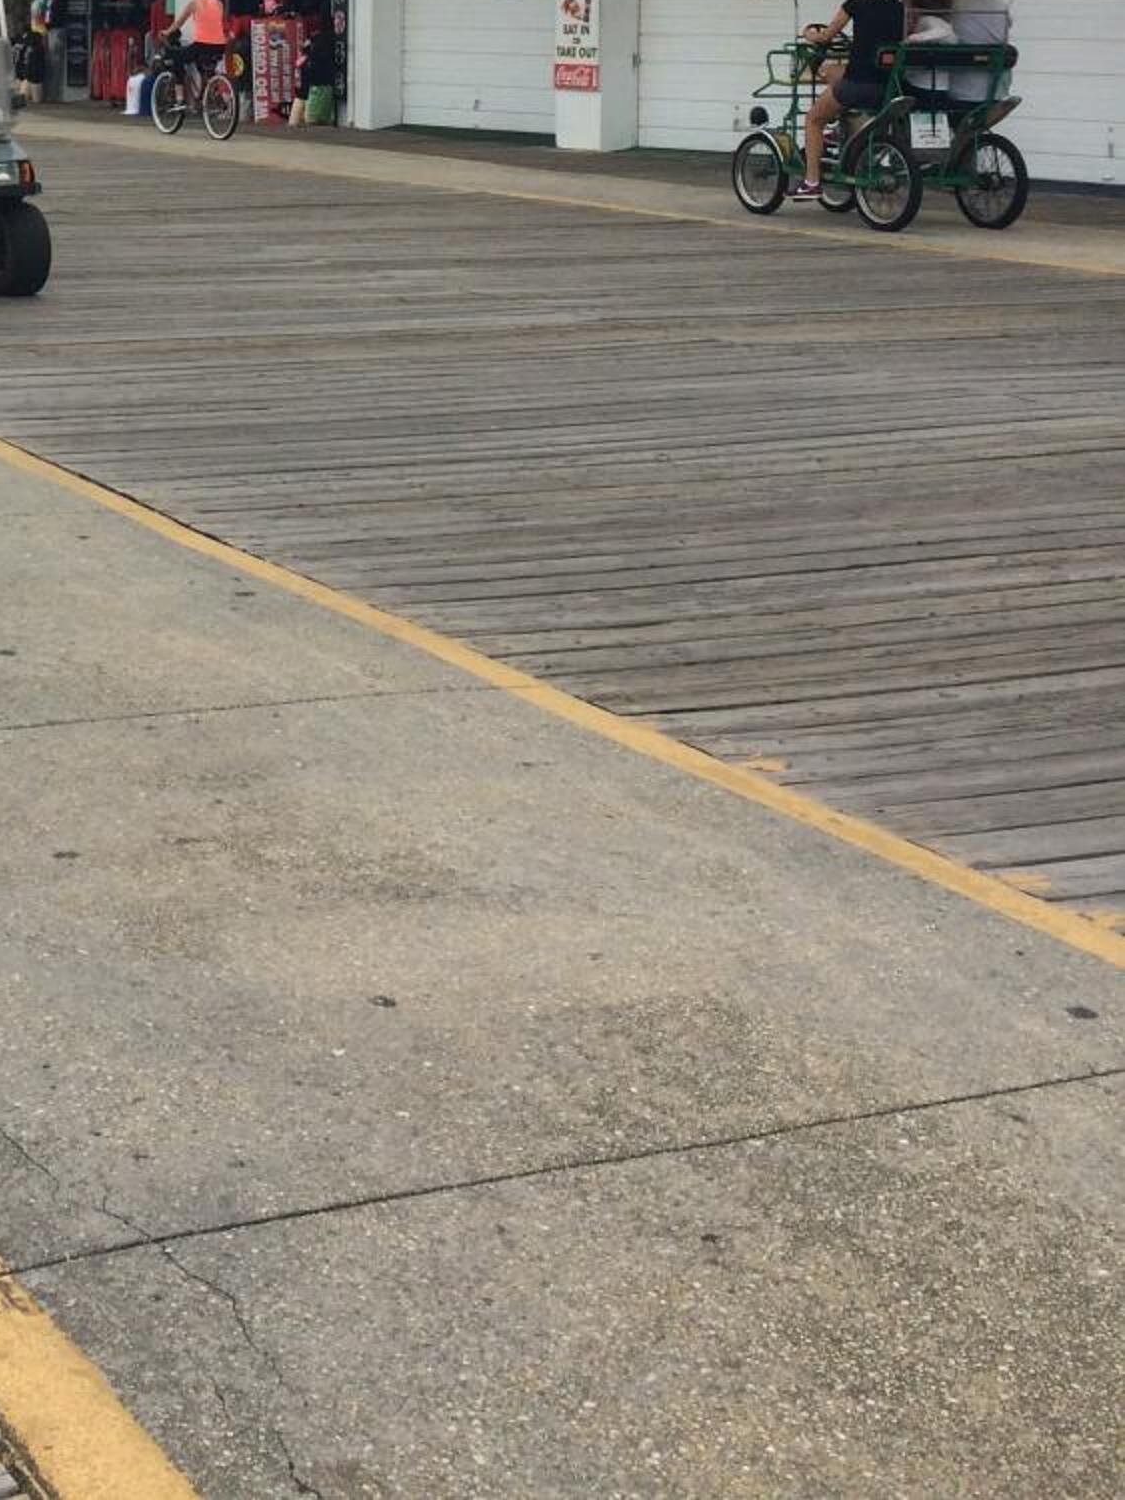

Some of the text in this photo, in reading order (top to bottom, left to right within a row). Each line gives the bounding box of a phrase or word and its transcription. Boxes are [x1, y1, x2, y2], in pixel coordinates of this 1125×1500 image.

[563, 24, 590, 35] EAT IN
[557, 47, 597, 59] TAKE OUT
